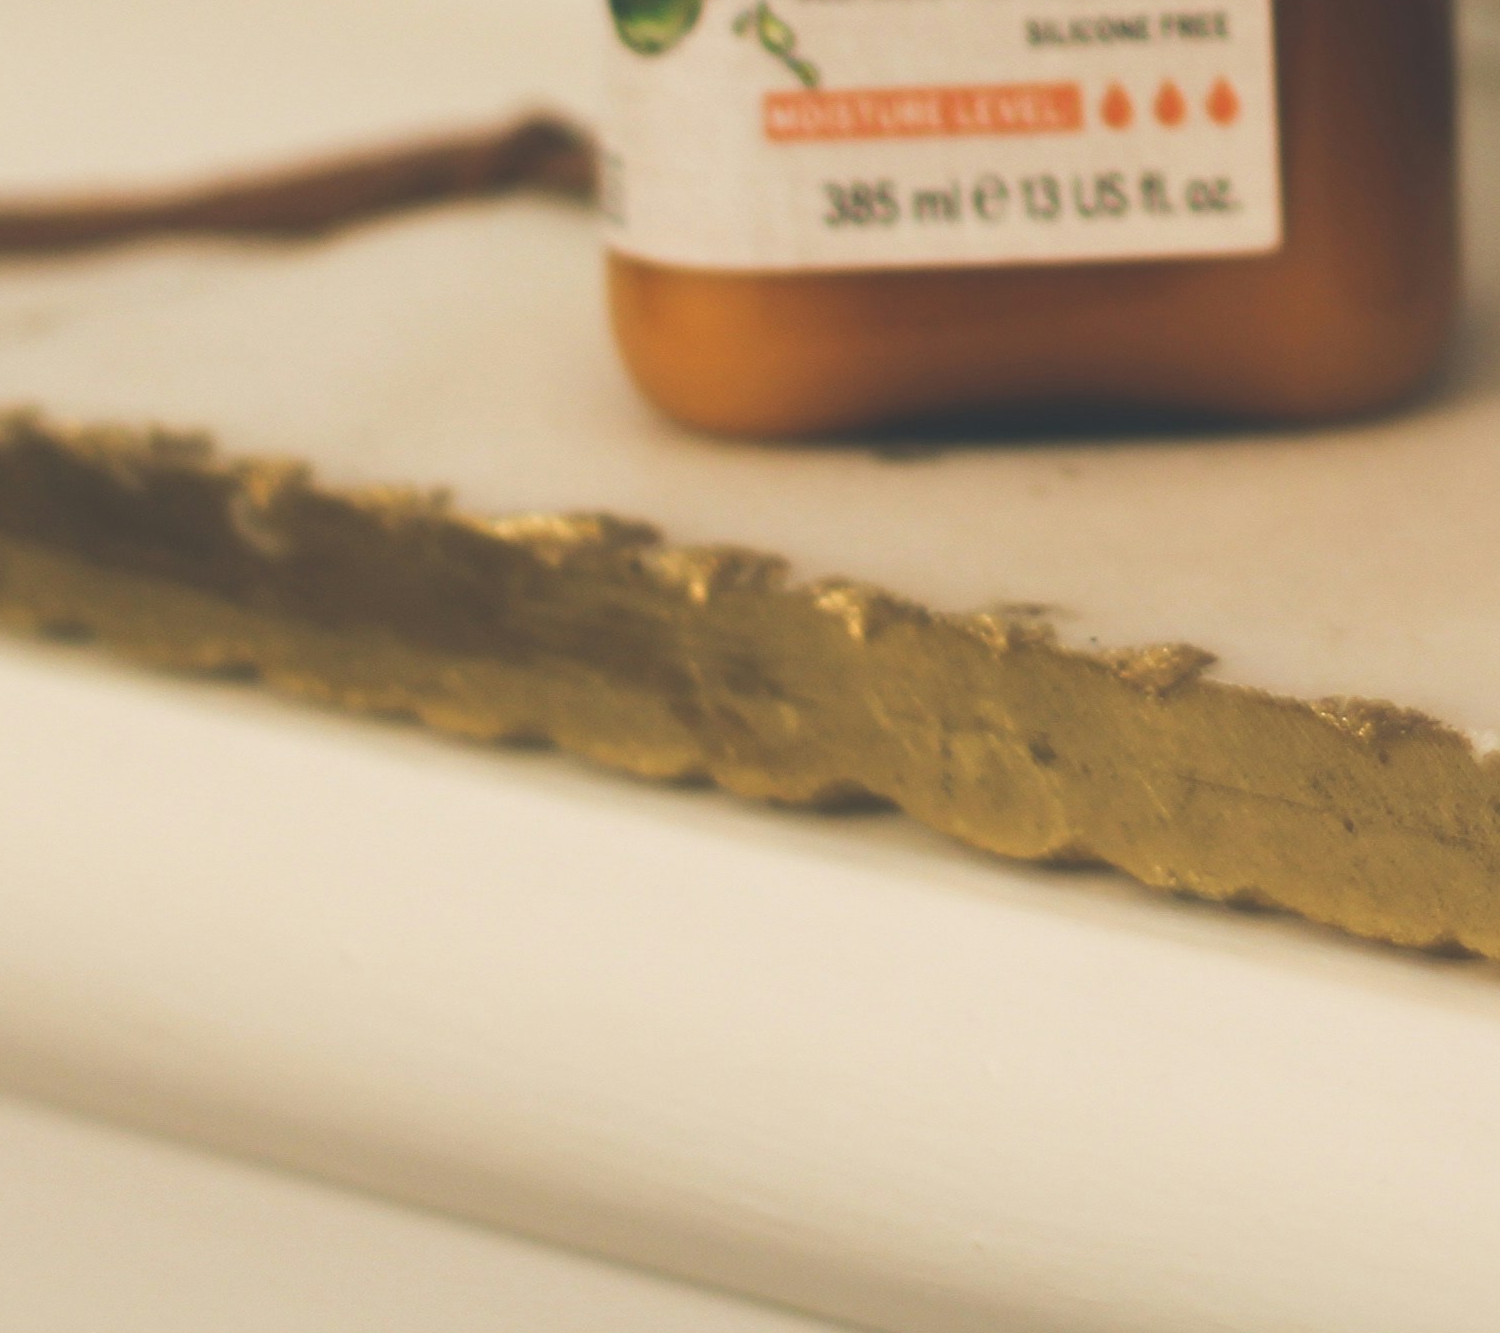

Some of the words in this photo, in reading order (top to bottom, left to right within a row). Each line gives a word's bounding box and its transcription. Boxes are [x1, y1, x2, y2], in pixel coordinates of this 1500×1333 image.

[1025, 14, 1149, 46] SILICONE
[1159, 11, 1229, 41] FREE
[771, 95, 940, 132] MOISTURE
[823, 180, 898, 228] 385
[913, 179, 961, 225] ml
[1021, 176, 1062, 220] 13
[1074, 172, 1127, 219] US
